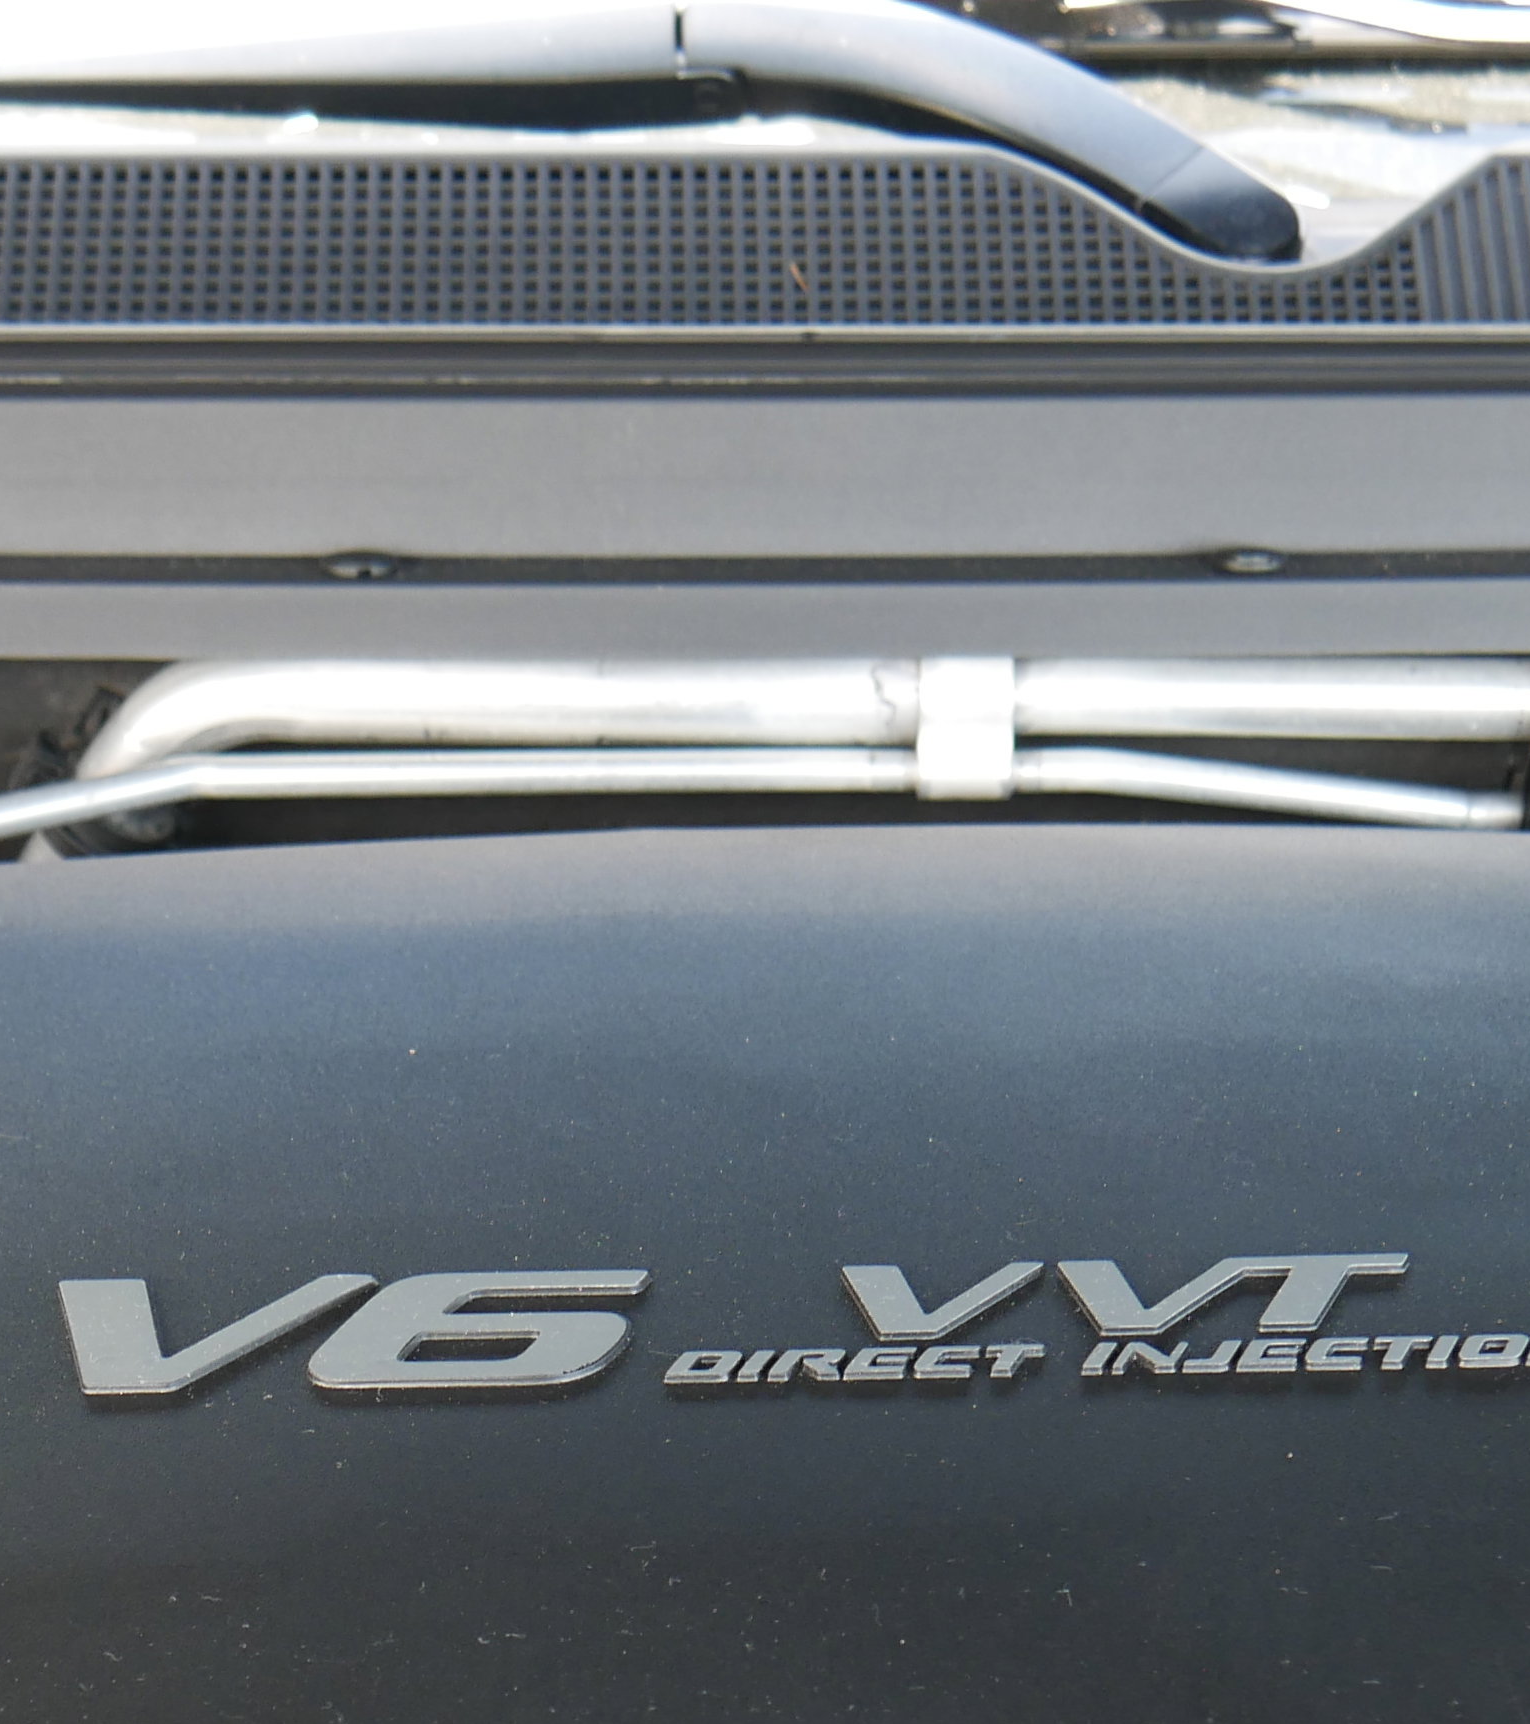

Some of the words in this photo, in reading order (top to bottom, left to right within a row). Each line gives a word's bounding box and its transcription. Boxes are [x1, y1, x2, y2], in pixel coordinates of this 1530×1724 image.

[59, 1270, 652, 1394] V6
[841, 1252, 1409, 1341] VVT
[663, 1343, 1049, 1384] DIRECT
